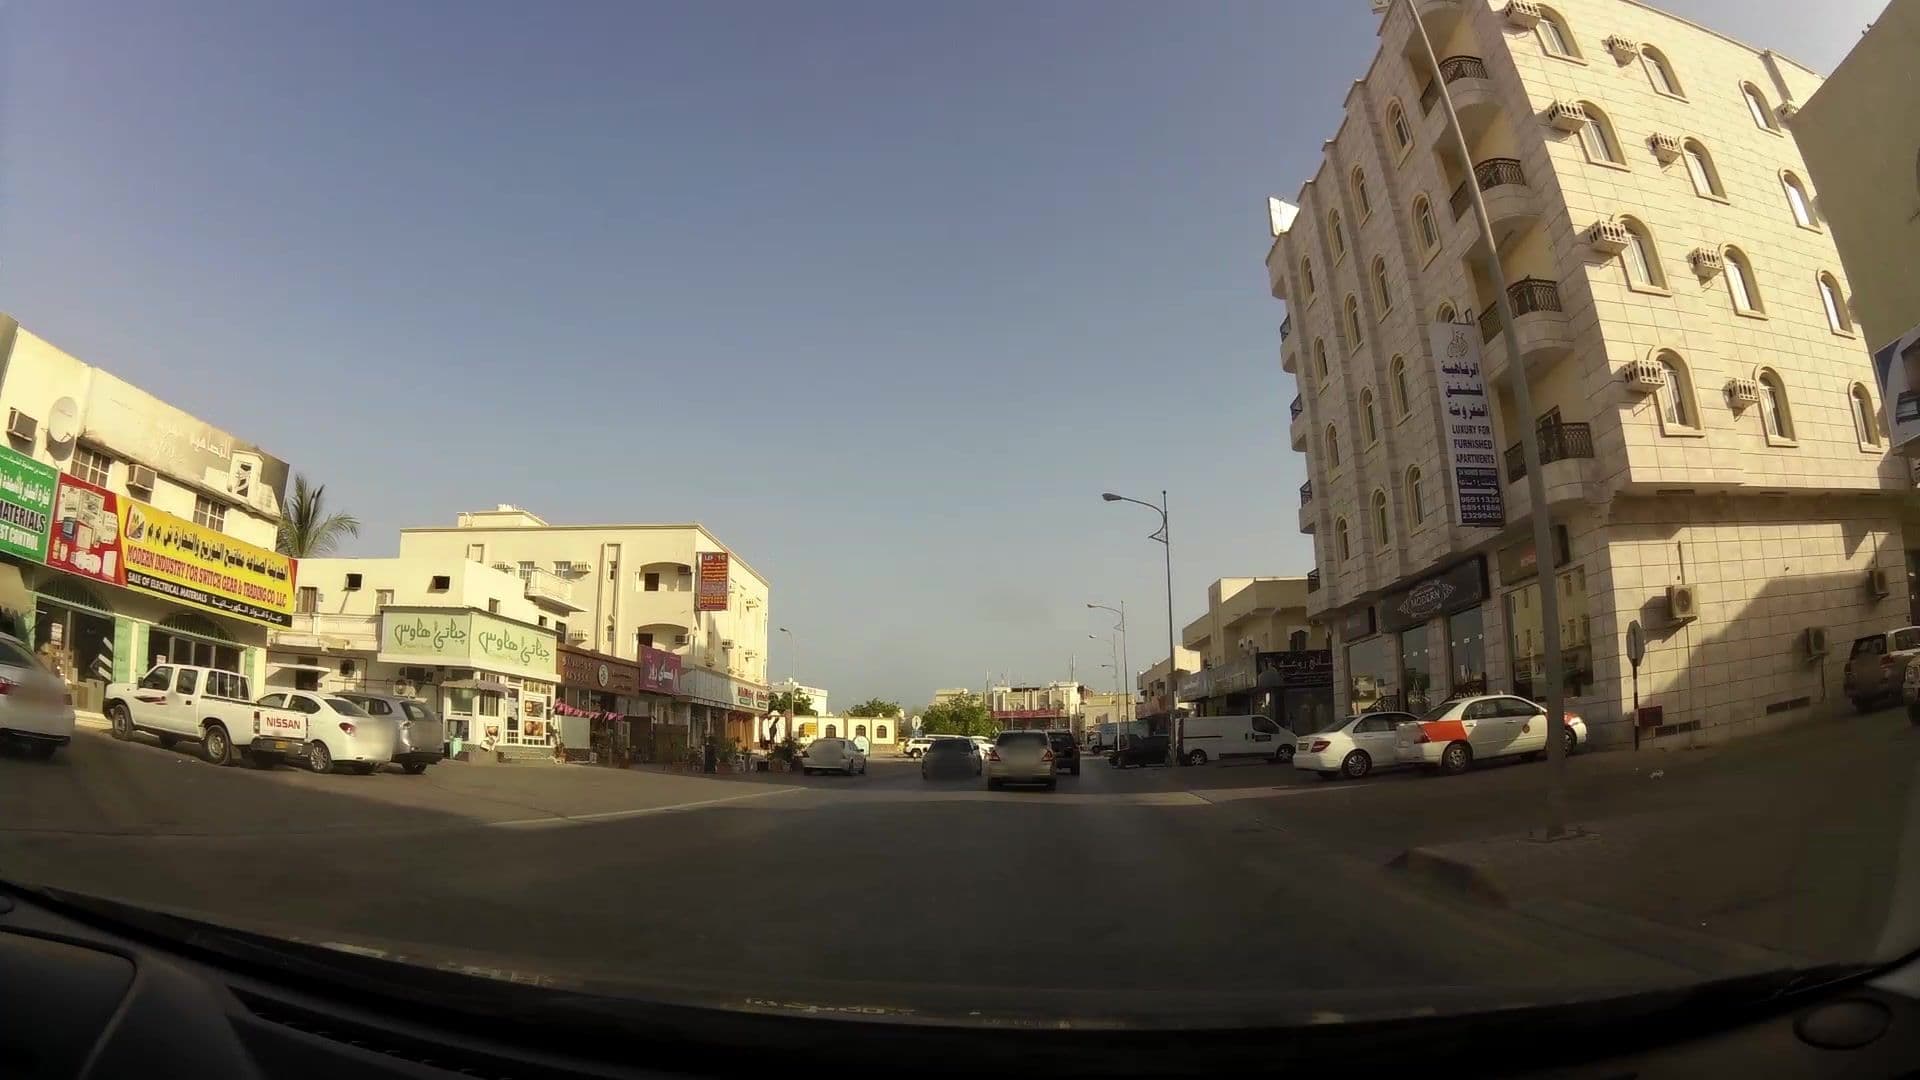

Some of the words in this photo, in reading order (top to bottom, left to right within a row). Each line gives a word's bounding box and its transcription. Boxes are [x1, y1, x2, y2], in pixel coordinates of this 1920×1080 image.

[1452, 424, 1476, 434] LUXURY
[1478, 426, 1490, 435] FOR
[1453, 438, 1492, 450] FURNISHED
[1456, 453, 1495, 464] APARTMENTS
[127, 544, 155, 569] MODERN
[154, 553, 186, 578] INDUSTRY
[185, 563, 199, 582] FOR
[198, 568, 222, 589] SWITCH
[222, 575, 238, 593] GEAR
[243, 582, 267, 601] TRADING
[276, 592, 288, 608] LLC
[128, 572, 141, 585] SALE
[142, 577, 150, 586] OF
[150, 579, 180, 595] ELECTRICAL
[180, 588, 208, 603] MATERIALS
[266, 716, 301, 730] NISSAN
